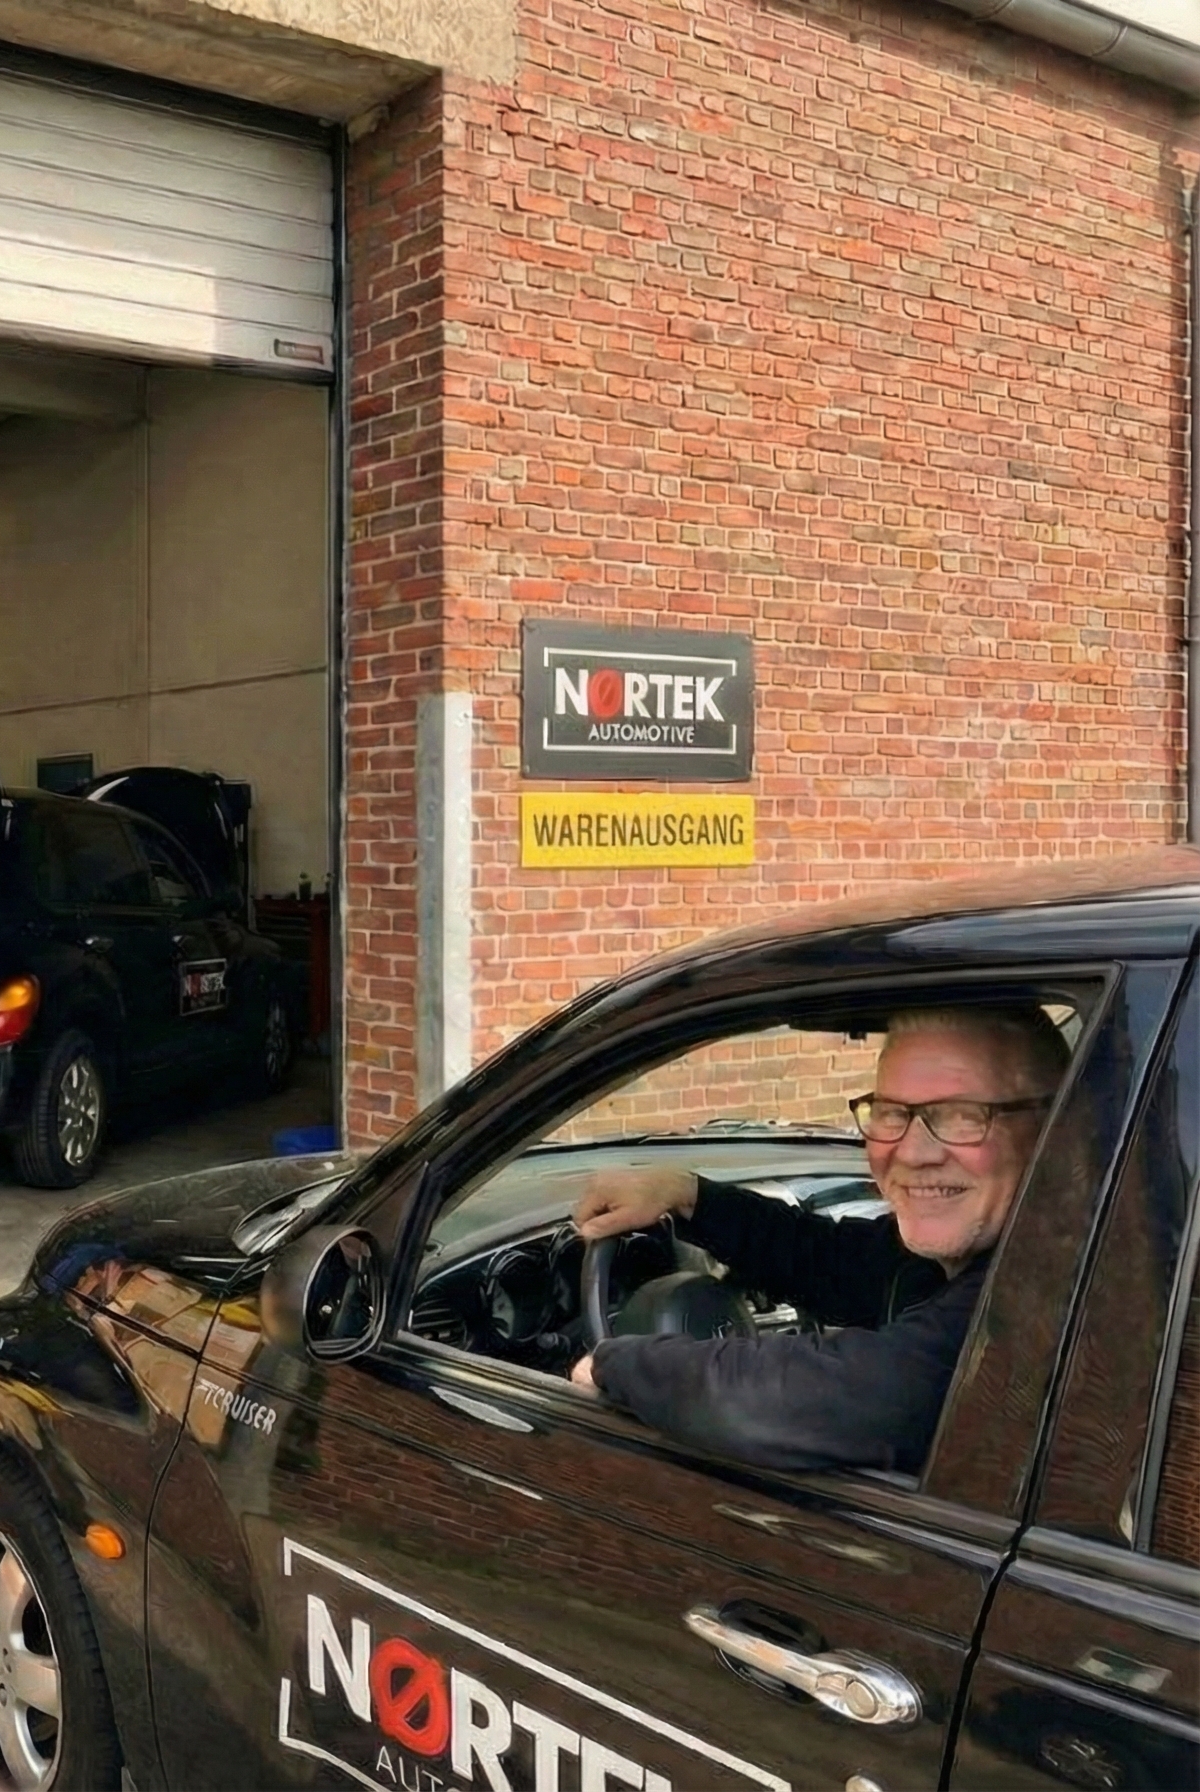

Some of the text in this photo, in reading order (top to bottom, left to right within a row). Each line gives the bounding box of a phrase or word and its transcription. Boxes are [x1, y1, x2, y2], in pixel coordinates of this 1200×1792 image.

[588, 724, 695, 744] AUTOMOTIVE
[533, 814, 744, 847] WARENAUSGANG
[212, 1388, 277, 1436] CRUISER
[376, 1746, 461, 1792] AUT
